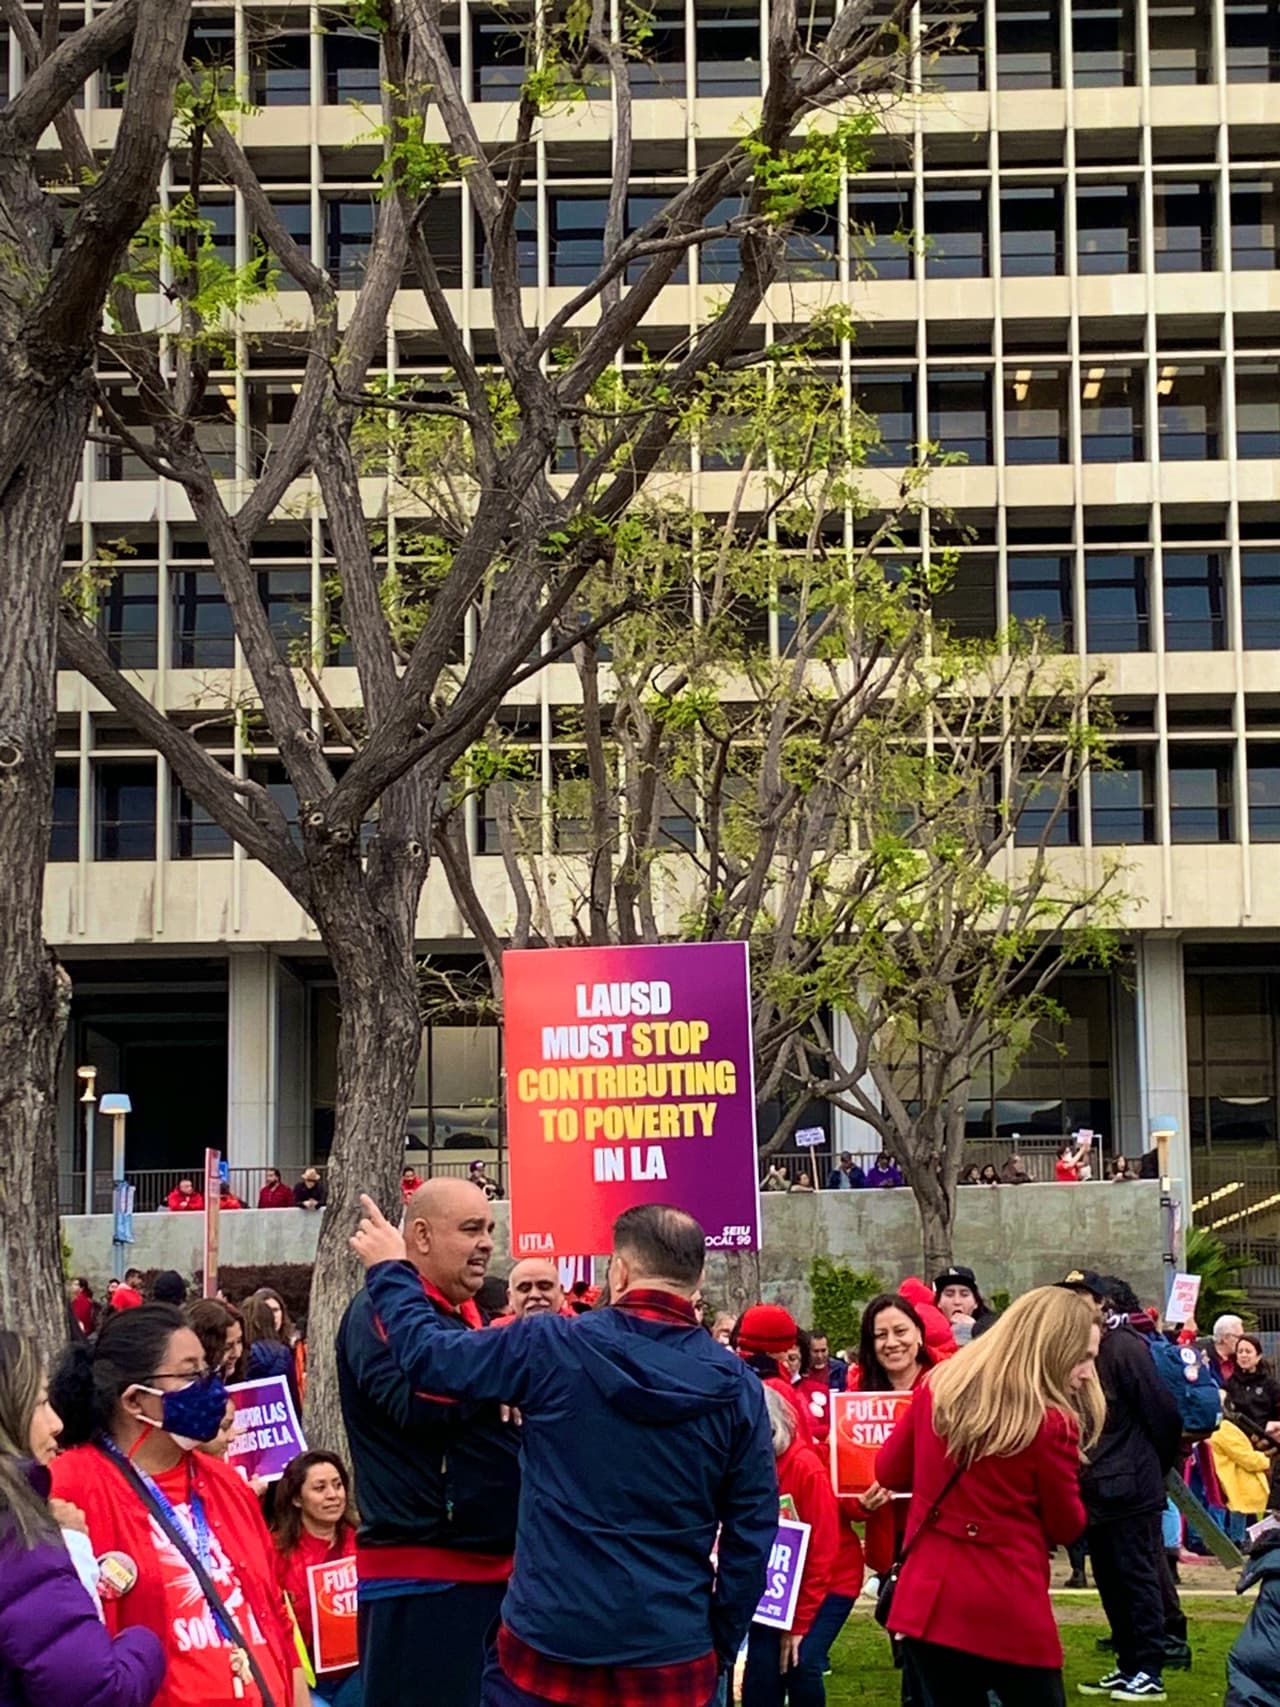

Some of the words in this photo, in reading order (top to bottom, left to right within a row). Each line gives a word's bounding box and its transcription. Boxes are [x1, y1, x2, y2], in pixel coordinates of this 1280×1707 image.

[576, 981, 671, 1018] LAUSD
[542, 1023, 626, 1060] MUST
[632, 1020, 709, 1057] STOP
[518, 1061, 737, 1102] CONTRIBUTING
[538, 1107, 579, 1143] TO
[585, 1102, 717, 1141] POVERTY
[593, 1147, 625, 1182] IN
[631, 1145, 668, 1181] LA
[519, 1233, 554, 1251] UTLA
[704, 1236, 734, 1247] OCAL
[736, 1235, 752, 1246] 99
[722, 1225, 751, 1236] SEIU
[262, 1402, 287, 1424] LAS
[846, 1399, 897, 1421] FULLY
[846, 1400, 897, 1421] FULLY
[258, 1429, 274, 1448] DE
[272, 1425, 294, 1445] LA
[852, 1422, 896, 1445] STAF
